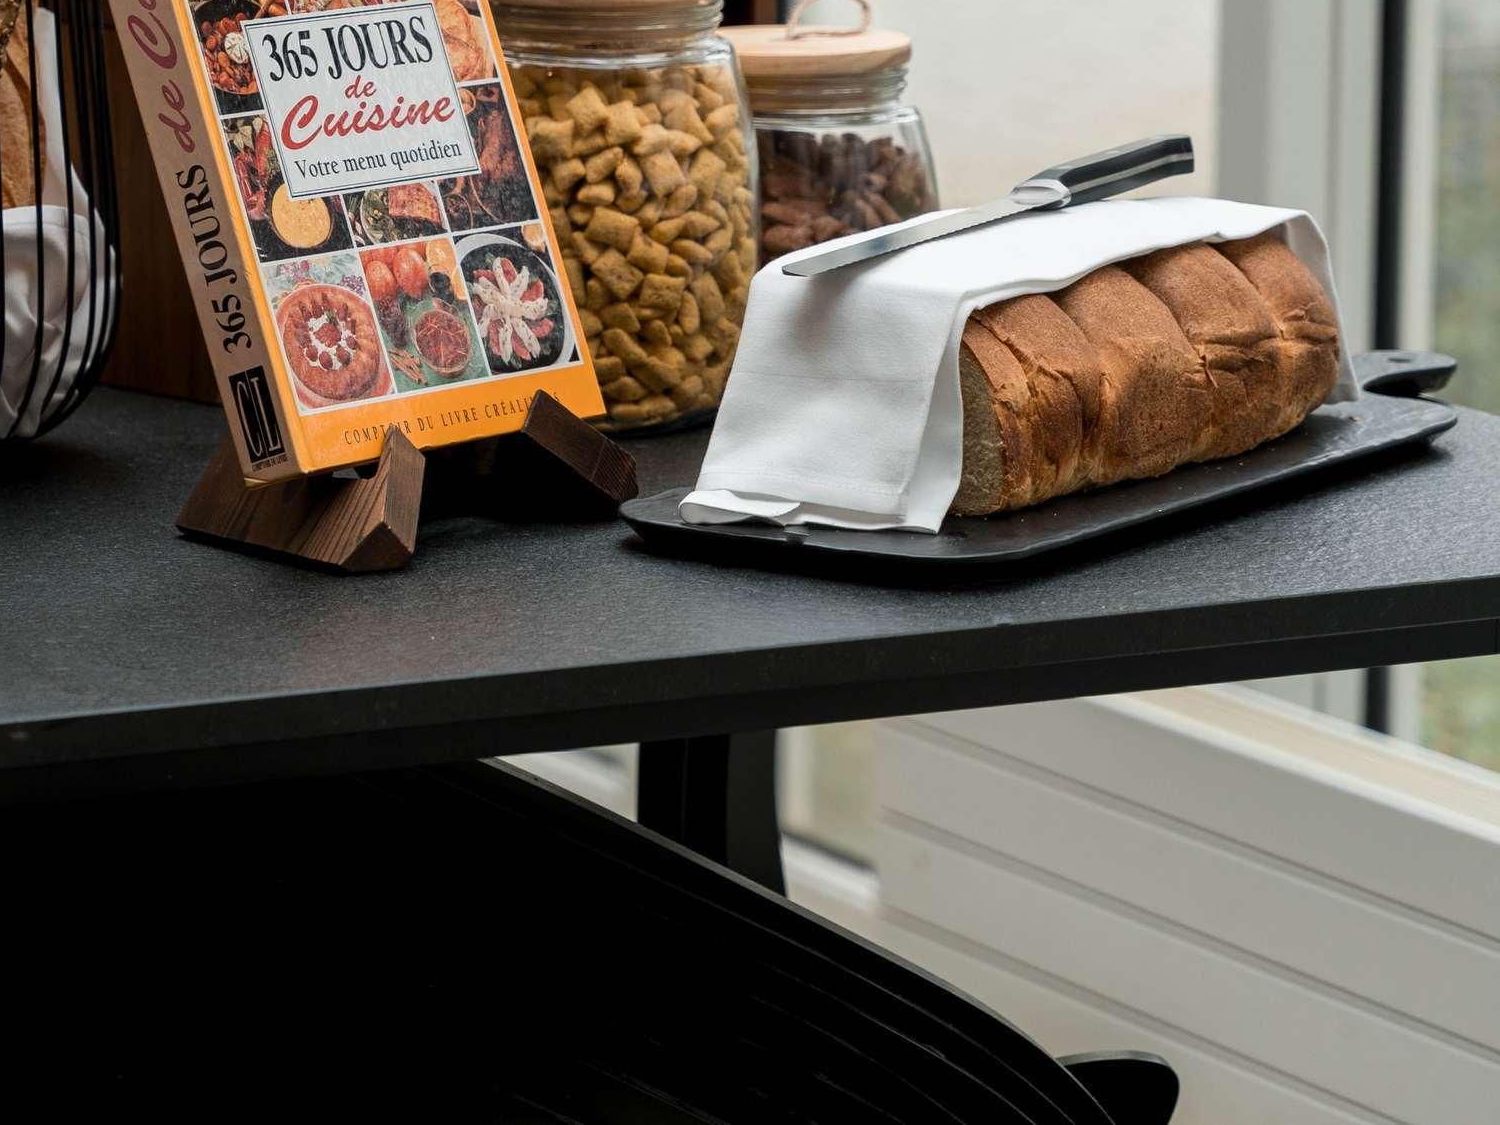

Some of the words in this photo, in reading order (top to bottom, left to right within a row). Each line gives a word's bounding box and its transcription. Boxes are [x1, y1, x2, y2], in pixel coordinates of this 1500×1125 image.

[261, 29, 319, 82] 365
[322, 16, 433, 80] JOURS
[158, 79, 196, 153] de
[344, 75, 377, 99] de
[280, 94, 456, 150] Cuisine
[294, 159, 339, 180] Votre
[342, 153, 387, 173] menu
[390, 139, 463, 171] quotidien
[175, 164, 238, 287] JOURS
[212, 293, 252, 355] 365
[344, 420, 412, 445] COMPTIR
[417, 415, 433, 431] DU
[440, 407, 478, 428] LIVRE
